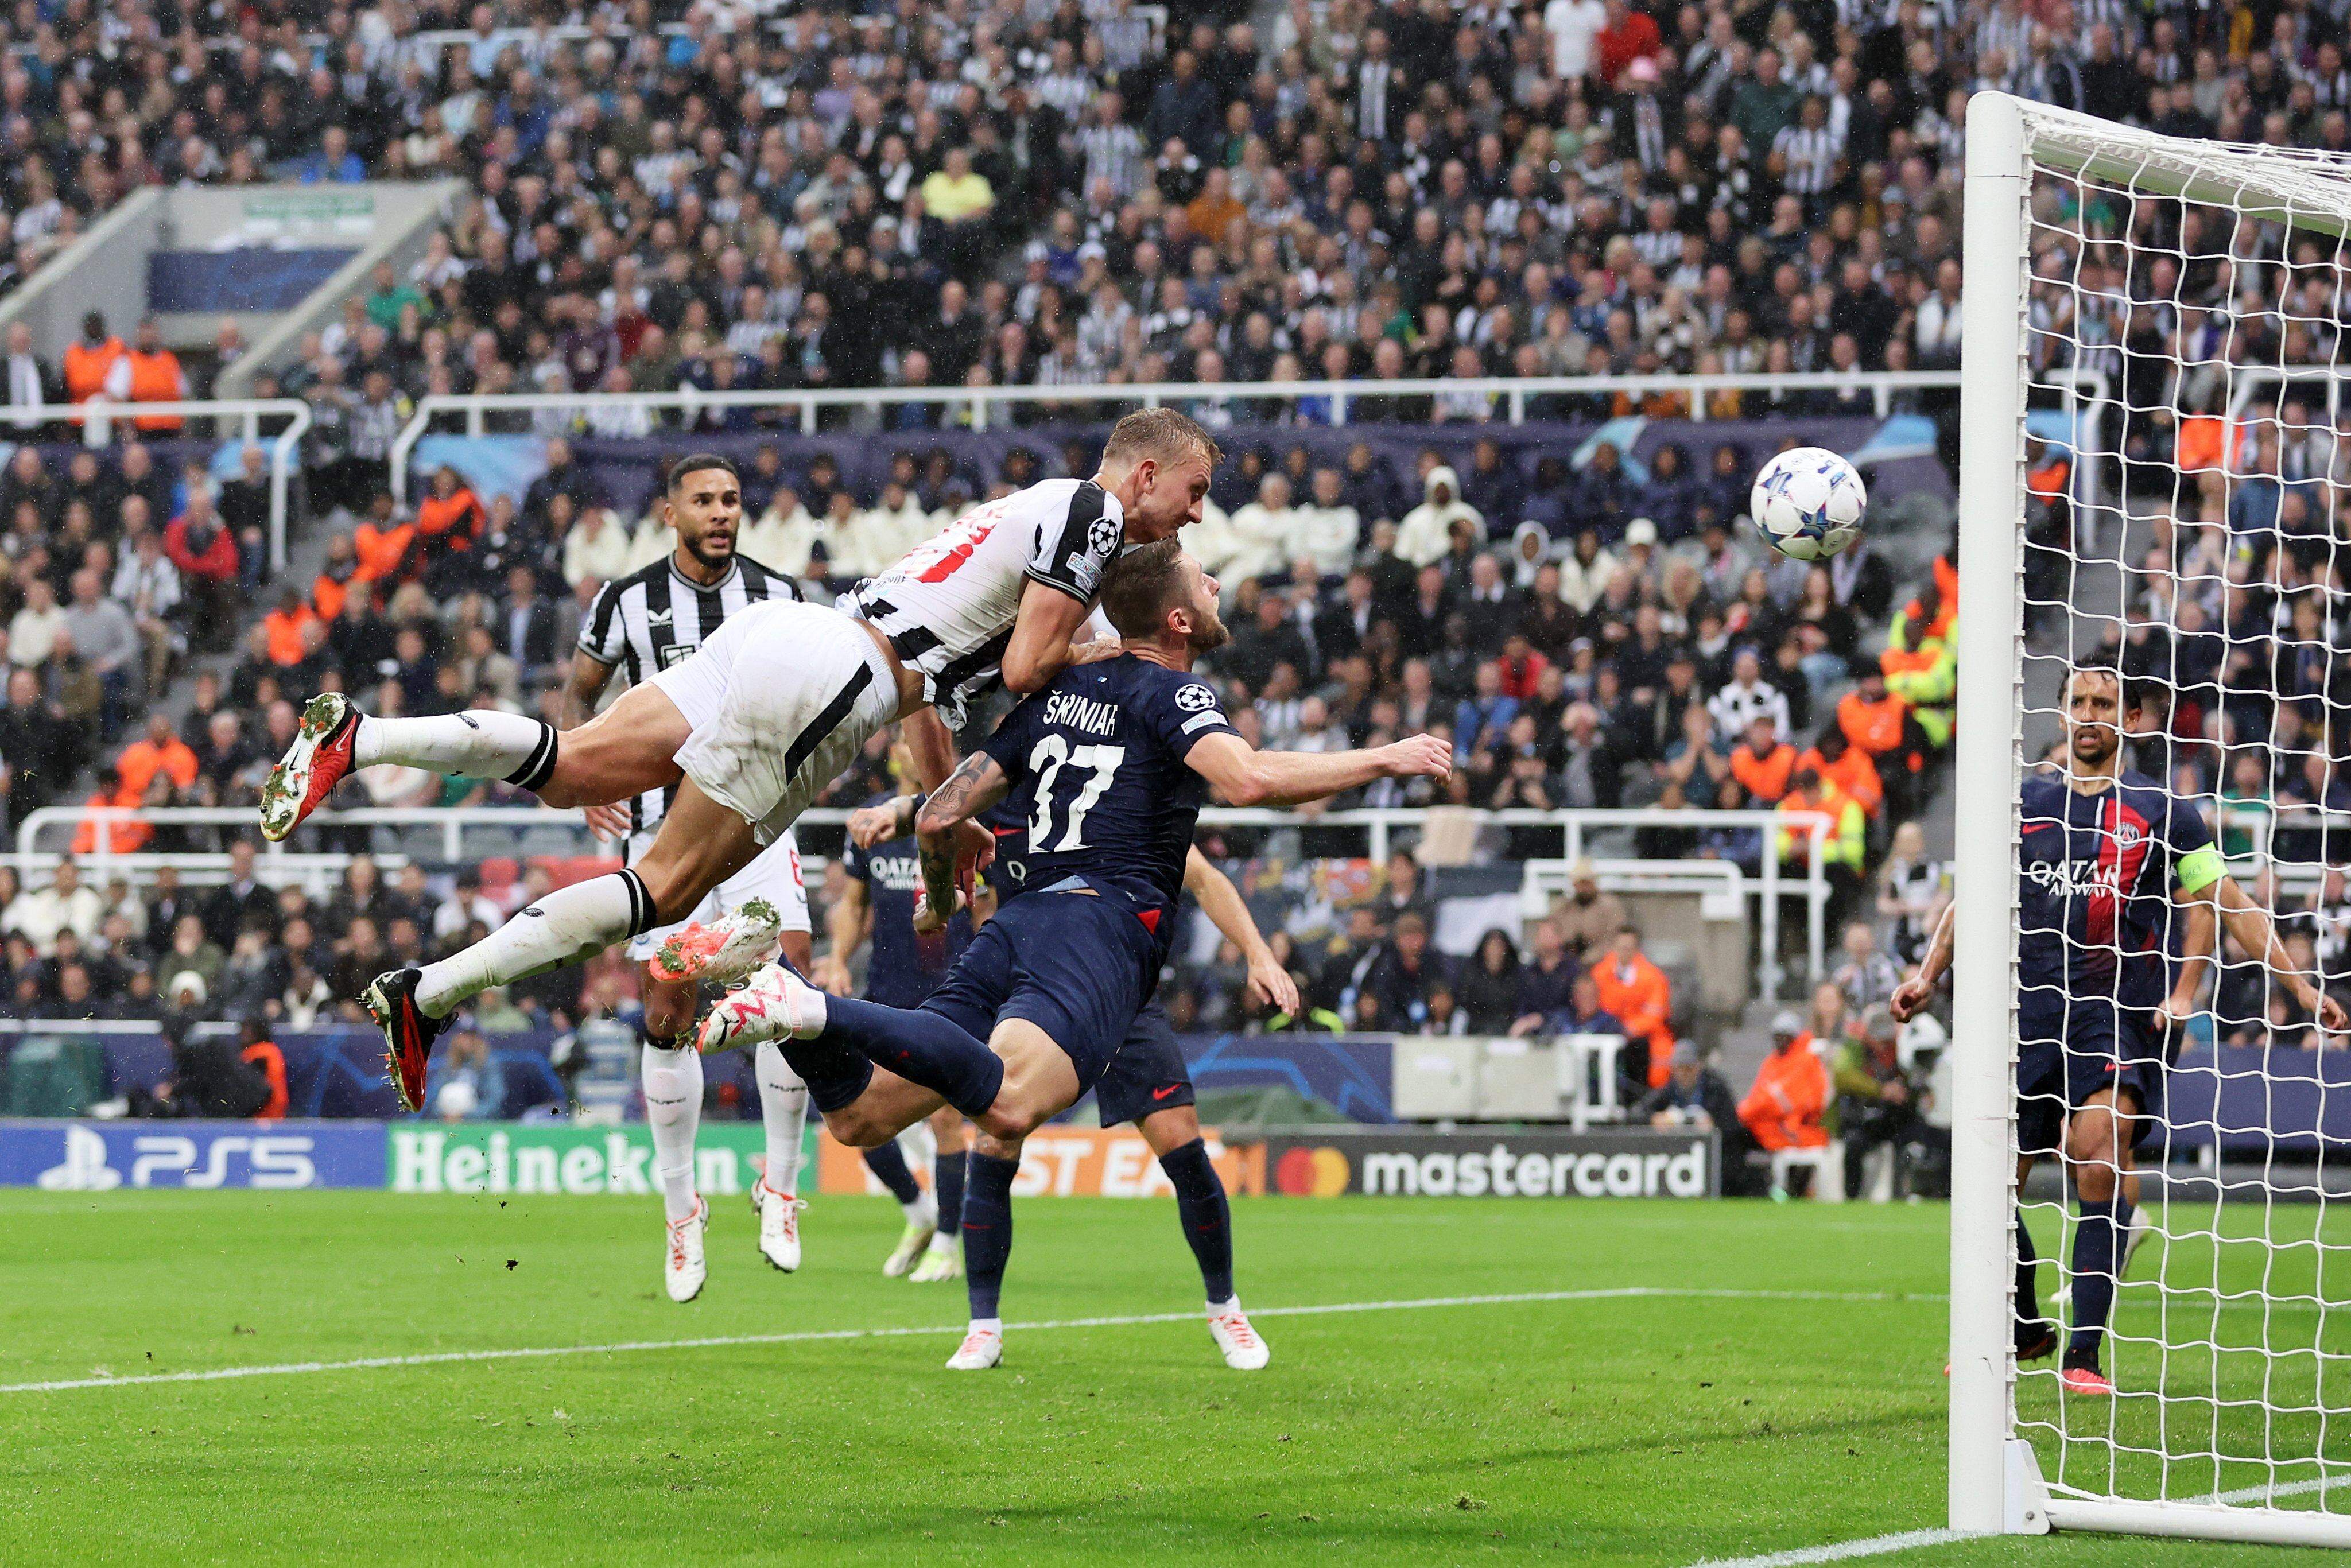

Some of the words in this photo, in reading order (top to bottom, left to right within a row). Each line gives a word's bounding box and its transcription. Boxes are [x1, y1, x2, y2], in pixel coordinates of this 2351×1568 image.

[1028, 733, 1126, 853] 37
[870, 856, 922, 882] QATA
[2048, 880, 2117, 898] AIWAY
[131, 1136, 316, 1189] PS5
[393, 1130, 741, 1194] Heinekn
[1009, 1138, 1094, 1197] ST
[1363, 1142, 1706, 1197] mastercard
